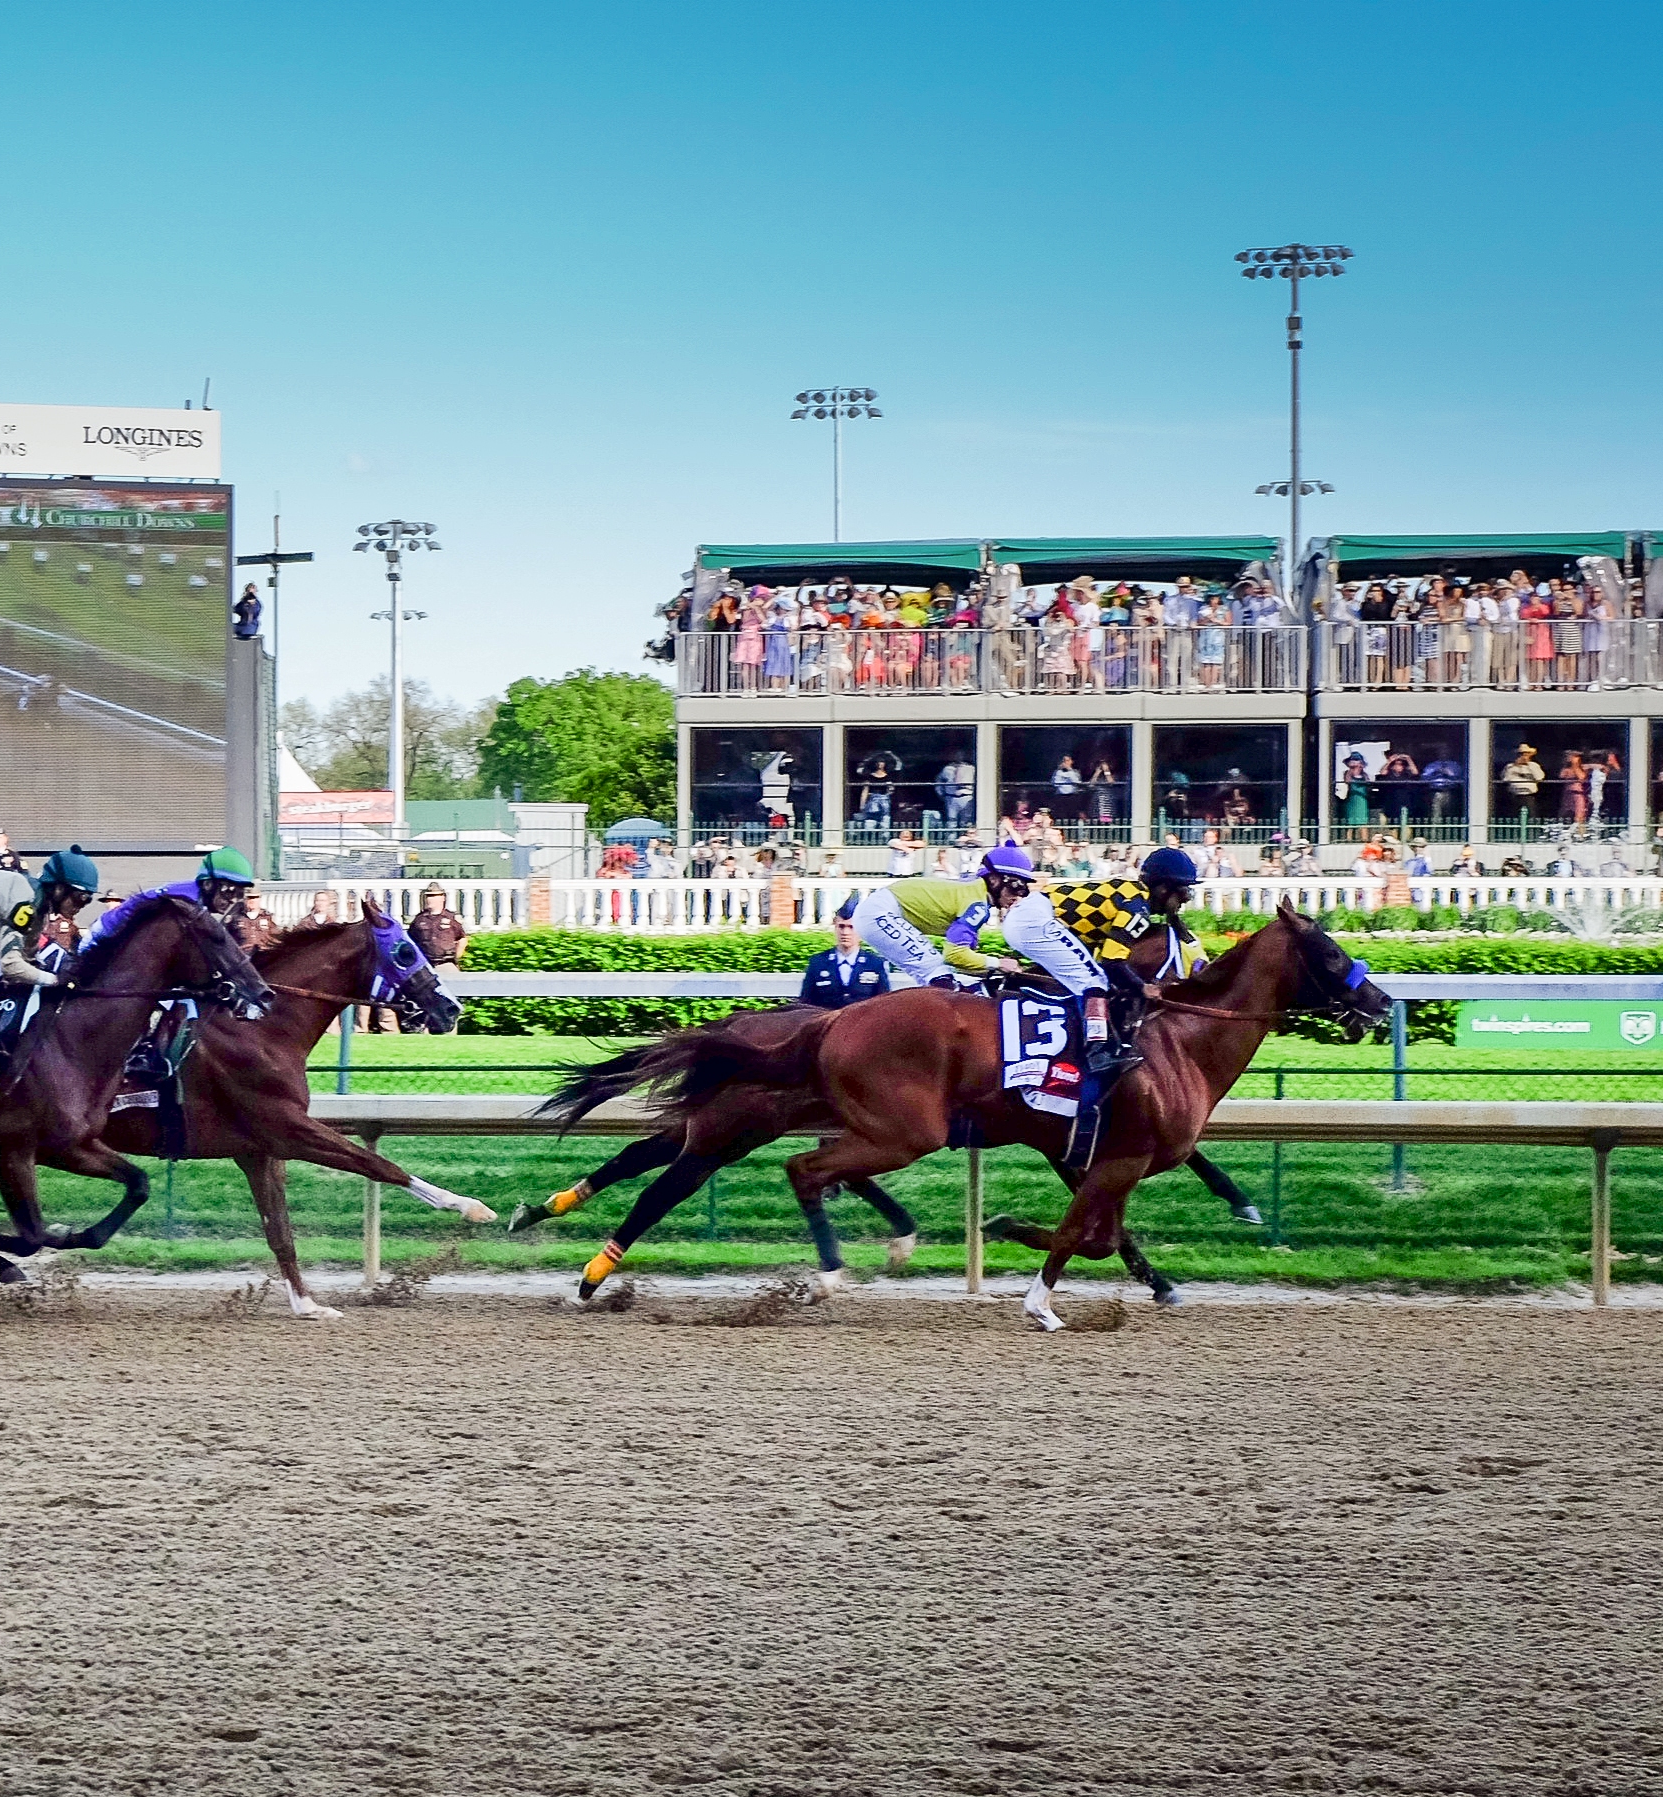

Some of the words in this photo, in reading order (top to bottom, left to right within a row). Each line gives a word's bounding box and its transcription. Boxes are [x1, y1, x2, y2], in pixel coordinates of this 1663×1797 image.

[83, 426, 204, 449] LONGINES
[13, 904, 34, 927] 6
[965, 904, 987, 927] 3
[1125, 913, 1150, 939] 13
[873, 914, 902, 940] ICED
[900, 935, 925, 962] TEA
[1059, 935, 1099, 977] RAM
[1001, 999, 1068, 1062] 13
